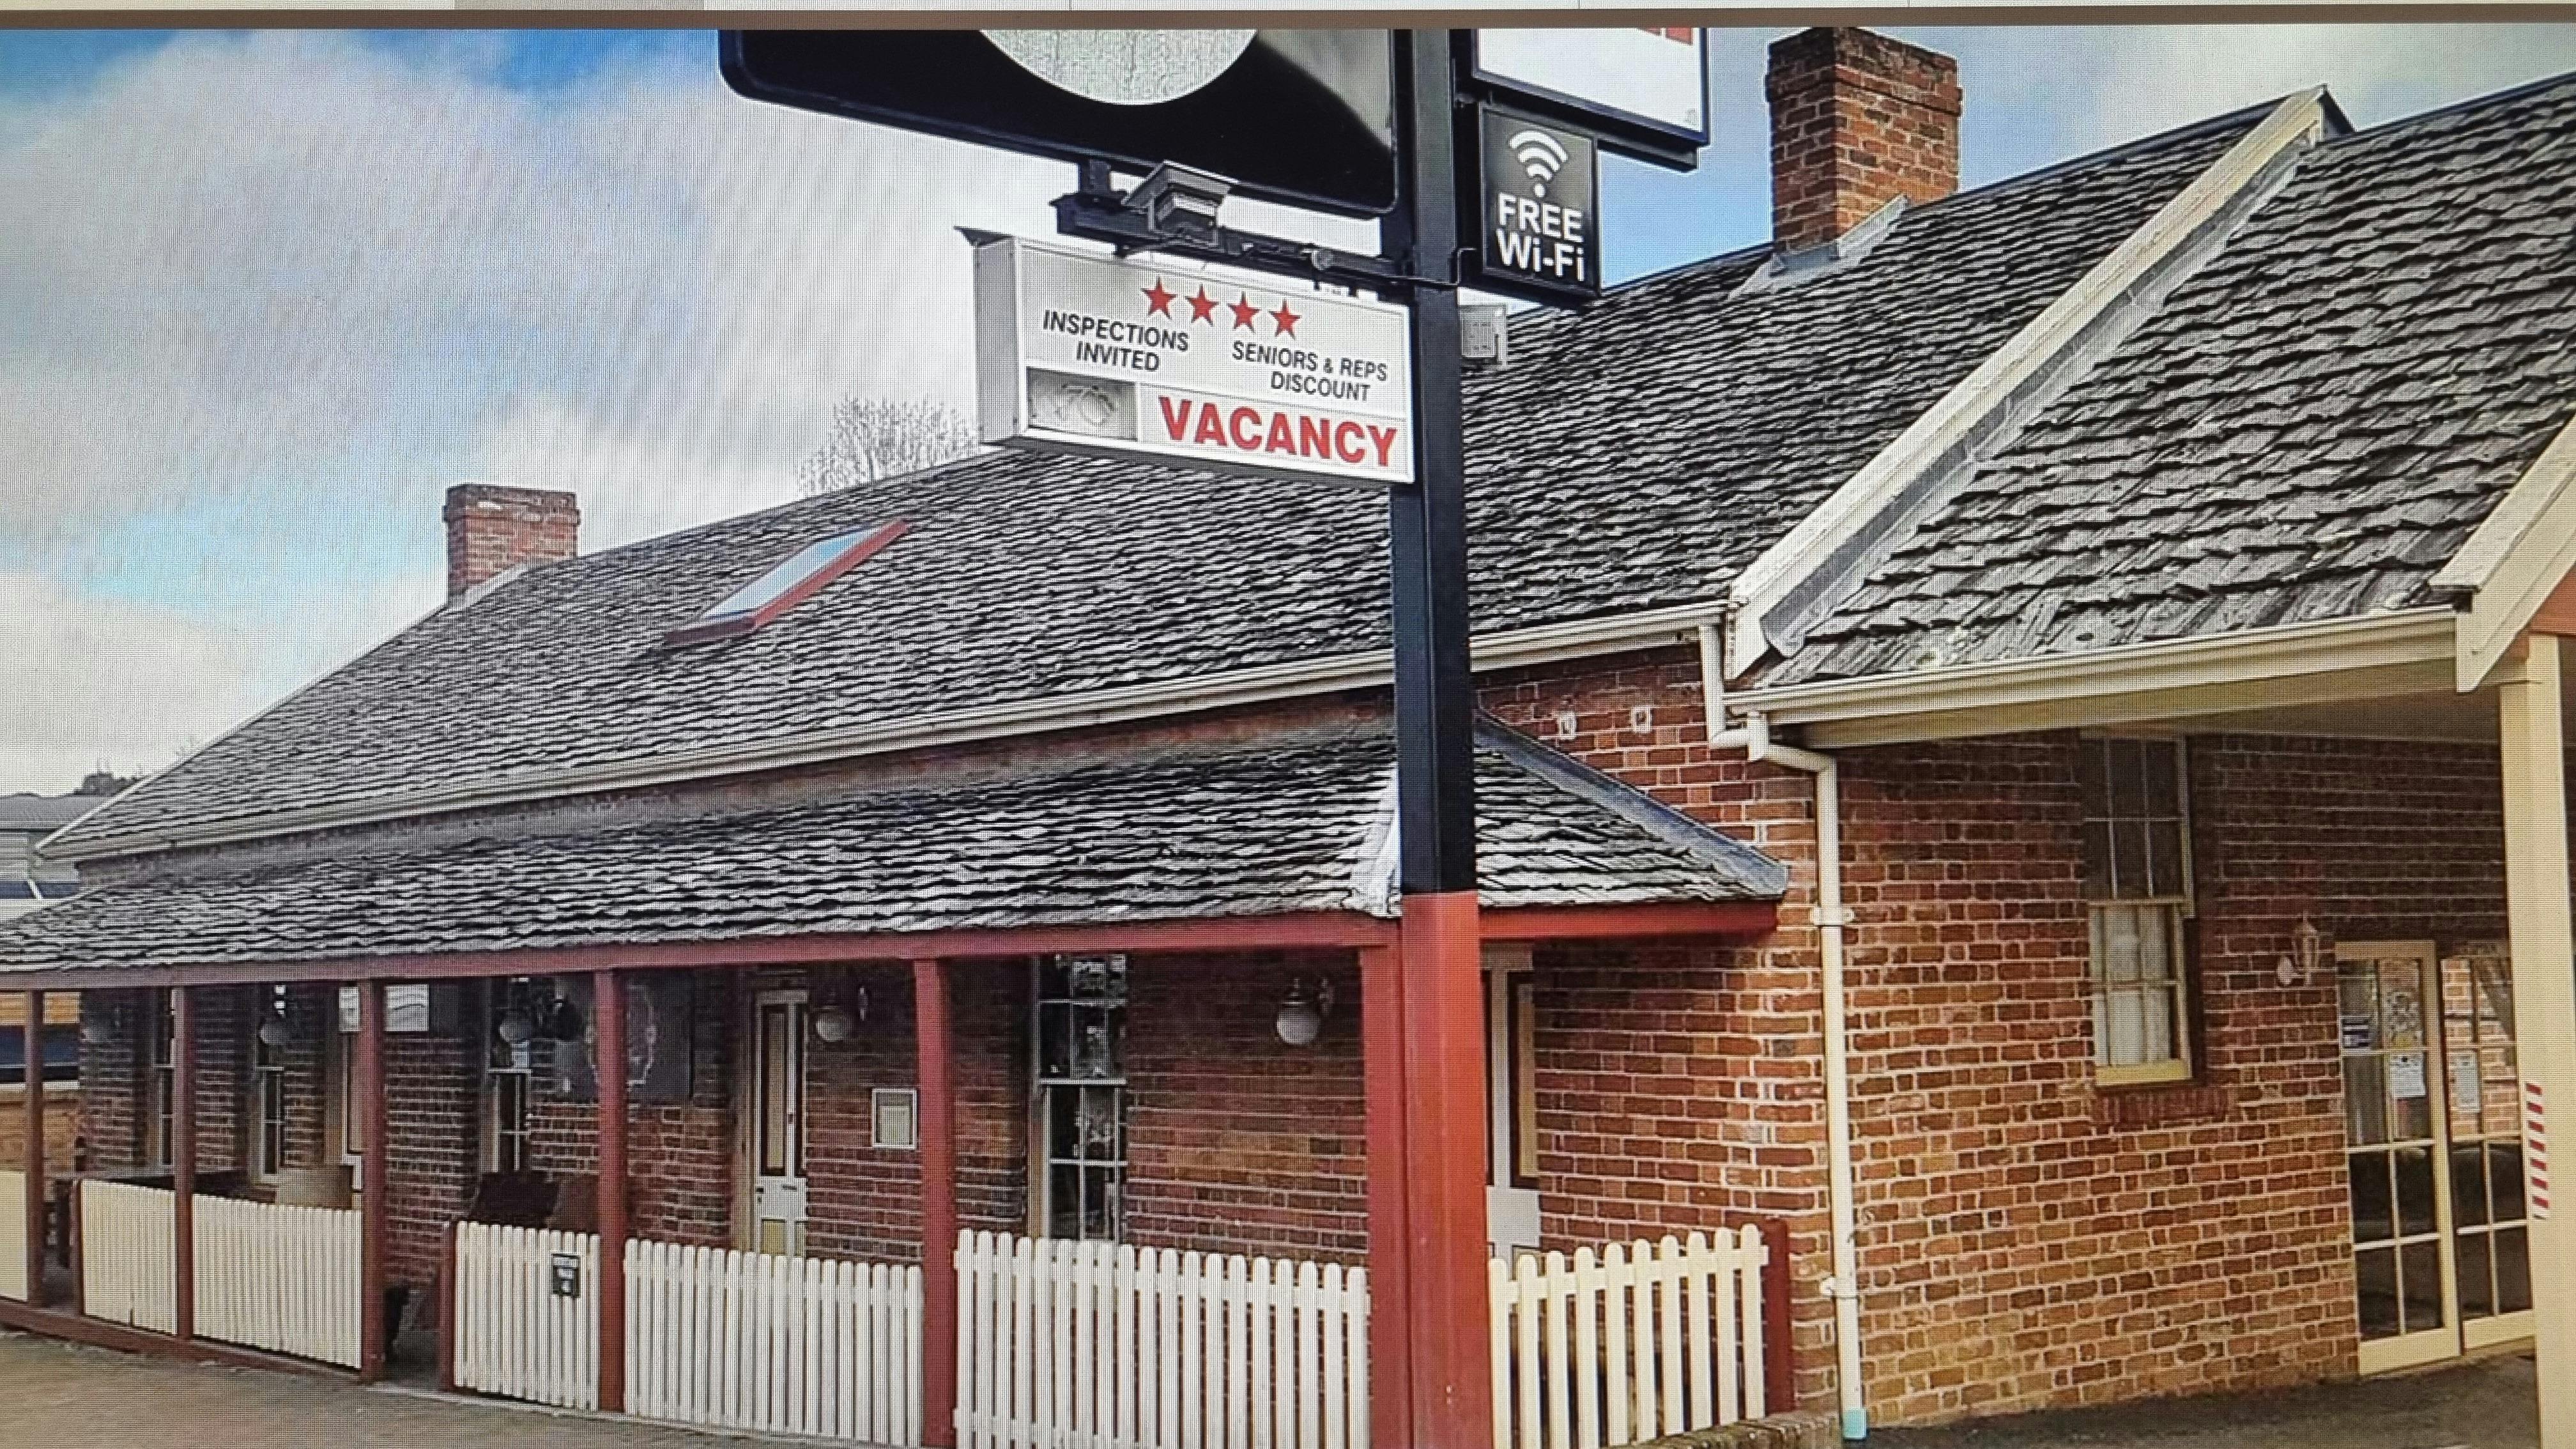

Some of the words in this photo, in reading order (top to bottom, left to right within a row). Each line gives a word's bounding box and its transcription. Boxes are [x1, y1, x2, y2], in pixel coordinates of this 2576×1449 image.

[1498, 192, 1583, 243] FREE
[1496, 228, 1584, 282] Wi-Fi
[1043, 309, 1189, 351] INSPECTIONS
[1076, 341, 1160, 372] INVITED
[1232, 340, 1318, 371] SENIORS
[1324, 357, 1333, 374] &
[1340, 357, 1388, 381] REPS
[1270, 371, 1370, 401] DISCOUNT
[1160, 395, 1397, 467] VACANCY
